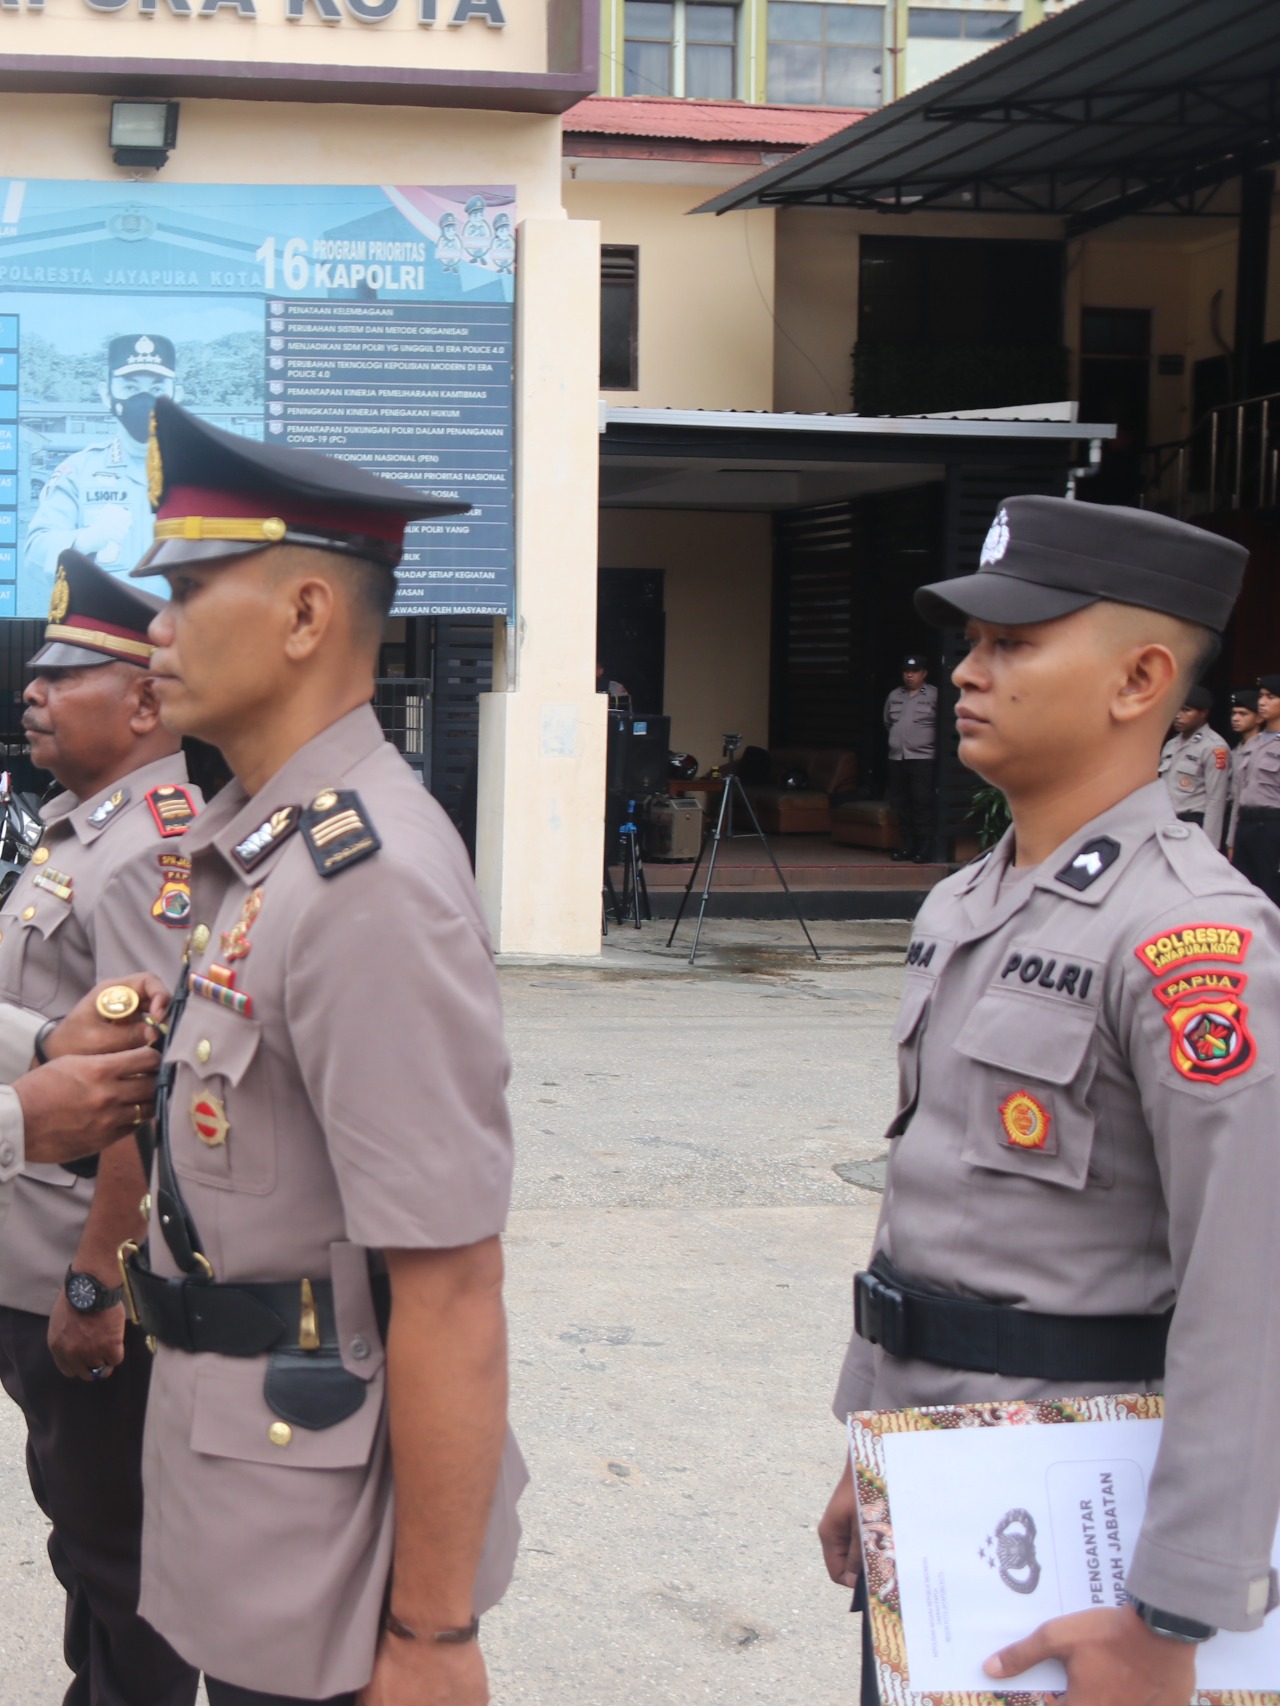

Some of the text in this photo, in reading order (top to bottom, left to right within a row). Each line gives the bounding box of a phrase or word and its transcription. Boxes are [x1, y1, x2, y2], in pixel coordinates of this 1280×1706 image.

[313, 239, 367, 261] PROGRAM
[369, 241, 426, 263] PRIORITAS
[256, 236, 309, 291] 16
[104, 268, 200, 287] JAYAPURA
[211, 270, 262, 288] KOTA
[314, 263, 425, 290] KAPOLRI
[288, 306, 394, 316] PENATAAN KELEMBAGAAN
[287, 324, 336, 333] PERUBAHAN
[337, 325, 364, 334] SISTEM
[365, 326, 383, 334] DAN
[385, 326, 417, 335] METODE
[418, 327, 469, 335] ORGANISASI
[287, 342, 341, 350] MENJADIKAN
[342, 343, 360, 351] SDM
[361, 343, 385, 352] POLRI
[386, 344, 399, 352] YG
[400, 344, 435, 353] UNGGUL
[435, 345, 445, 353] DI
[445, 345, 462, 353] ERA
[462, 345, 491, 354] POLICE
[287, 360, 493, 372] PERUBAHAN TEKNOLOGI KEPOLISIAN MODERN DI ERA
[287, 370, 317, 378] POLICE
[287, 388, 487, 399] PEMANTAPAN KINERJA PEMELIHARAAN KAMTIBMAS
[286, 407, 460, 418] PENINGKATAN KINERJA PENEGAKAN HUKUM
[286, 425, 504, 436] PEMANTAPAN DUKUNGAN POLRI DALAM PENANGANAN
[286, 434, 328, 443] COVID-19
[374, 453, 416, 462] NASIONAL
[380, 472, 423, 480] PROGRAM
[423, 472, 463, 481] PRIORITAS
[464, 472, 506, 481] NASIONAL
[431, 490, 460, 498] SOSIAL
[421, 526, 444, 534] POLRI
[445, 526, 470, 534] YANG
[427, 571, 454, 579] SETIAP
[454, 571, 495, 579] KEGIATAN
[453, 607, 507, 615] MASYARAKAT
[1144, 927, 1241, 961] POLRESTA
[1154, 942, 1239, 969] JAYAPURA KOTA
[1000, 952, 1093, 999] POLRI
[1167, 974, 1233, 997] PAPUA
[1099, 1471, 1121, 1552] JABATAN
[1079, 1498, 1105, 1604] PENGANTAR
